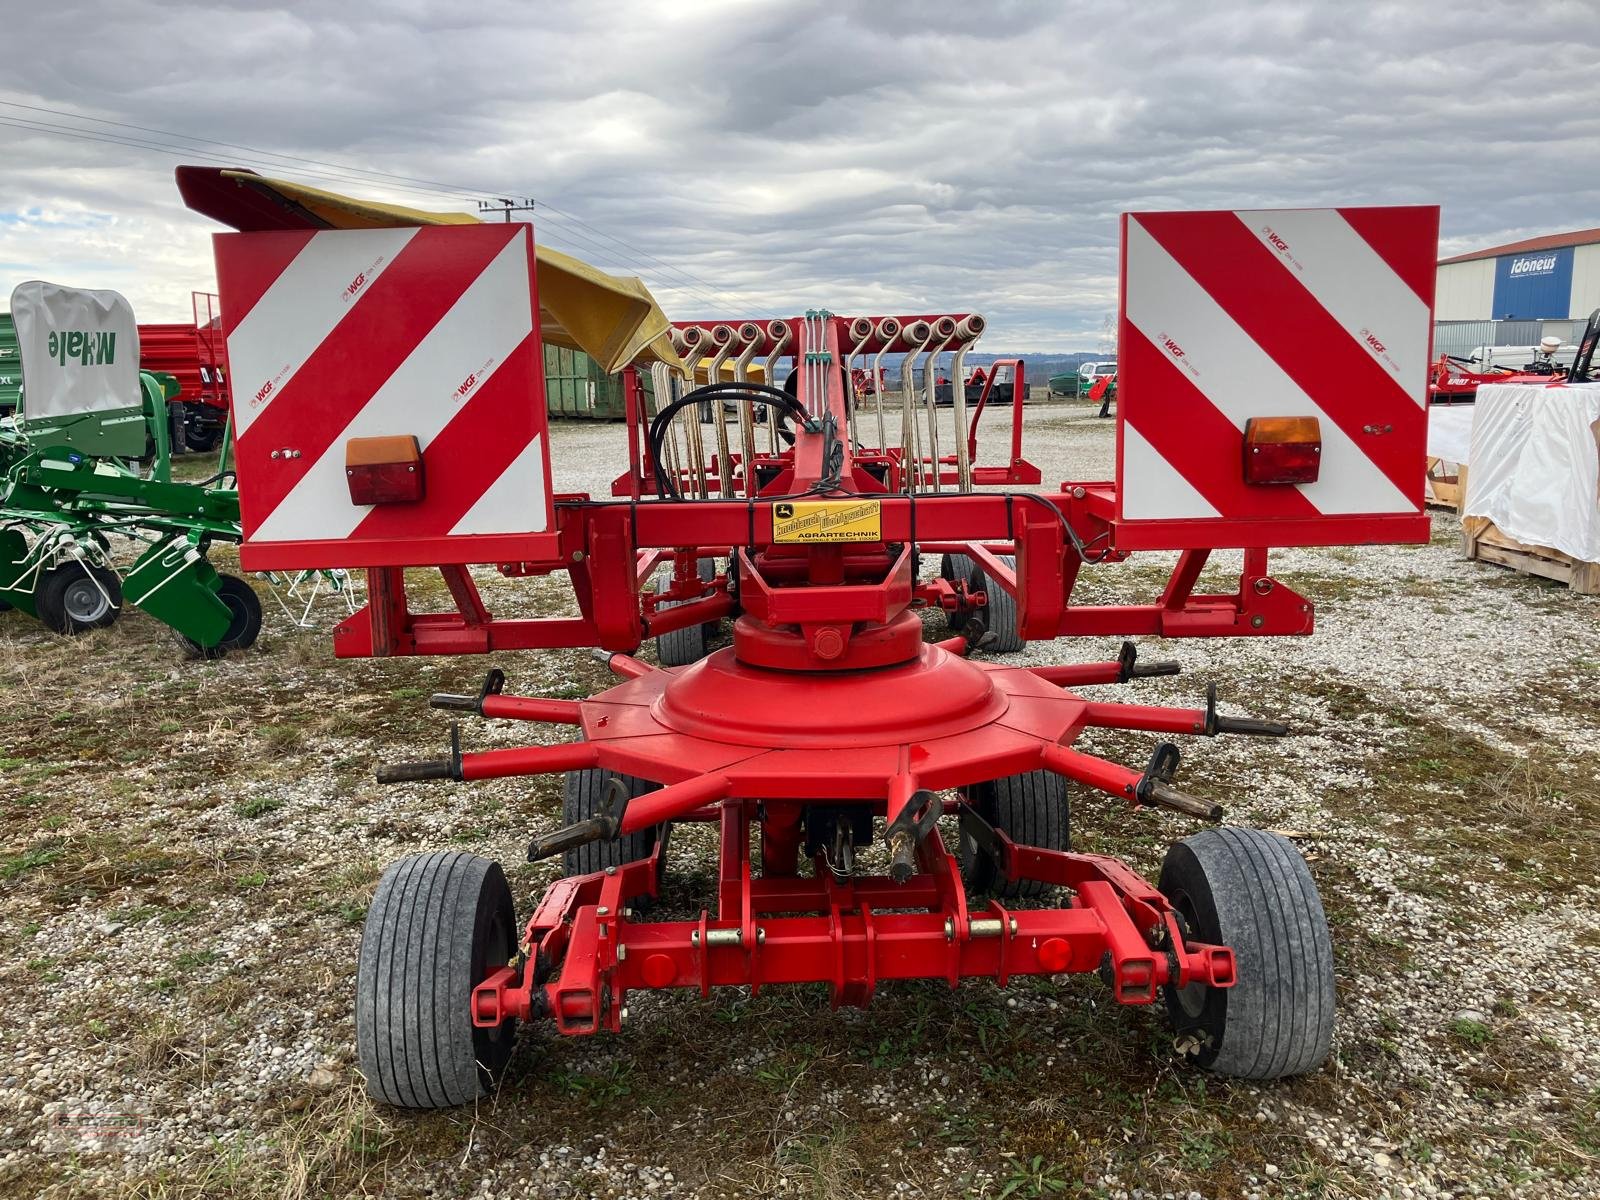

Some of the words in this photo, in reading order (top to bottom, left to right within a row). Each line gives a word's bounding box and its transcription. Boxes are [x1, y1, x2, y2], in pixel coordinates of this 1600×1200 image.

[1268, 232, 1289, 253] WGF
[1511, 256, 1556, 275] idoneus
[346, 272, 366, 295] WGF
[1164, 338, 1185, 359] WGF
[1366, 334, 1387, 354] WGF
[254, 380, 274, 402] WGF
[457, 373, 477, 395] WGF
[797, 531, 879, 539] AGRARTECHNIK
